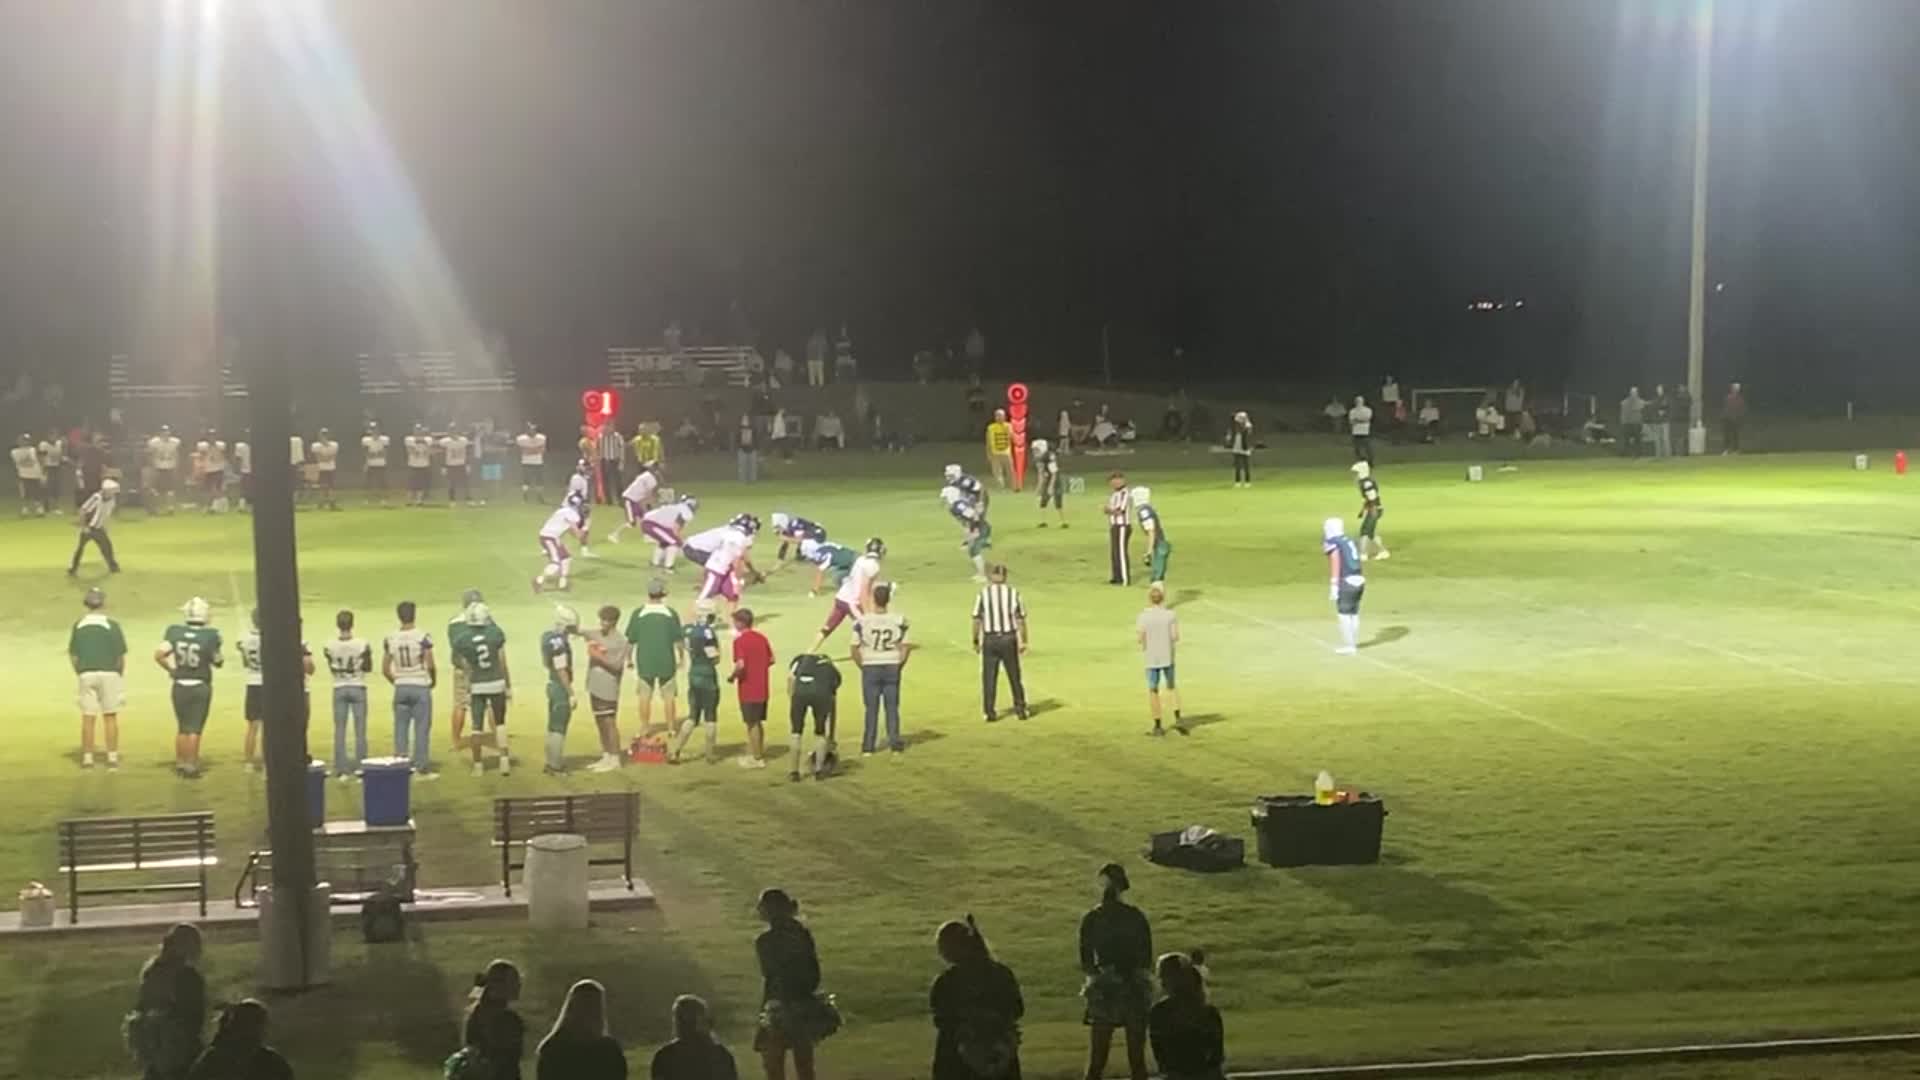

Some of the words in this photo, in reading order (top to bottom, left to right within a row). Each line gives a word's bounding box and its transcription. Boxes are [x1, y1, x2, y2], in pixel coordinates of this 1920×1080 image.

[600, 391, 613, 416] 1
[871, 628, 894, 652] 72
[175, 641, 201, 669] 56
[398, 645, 412, 669] 11
[475, 643, 491, 670] 2
